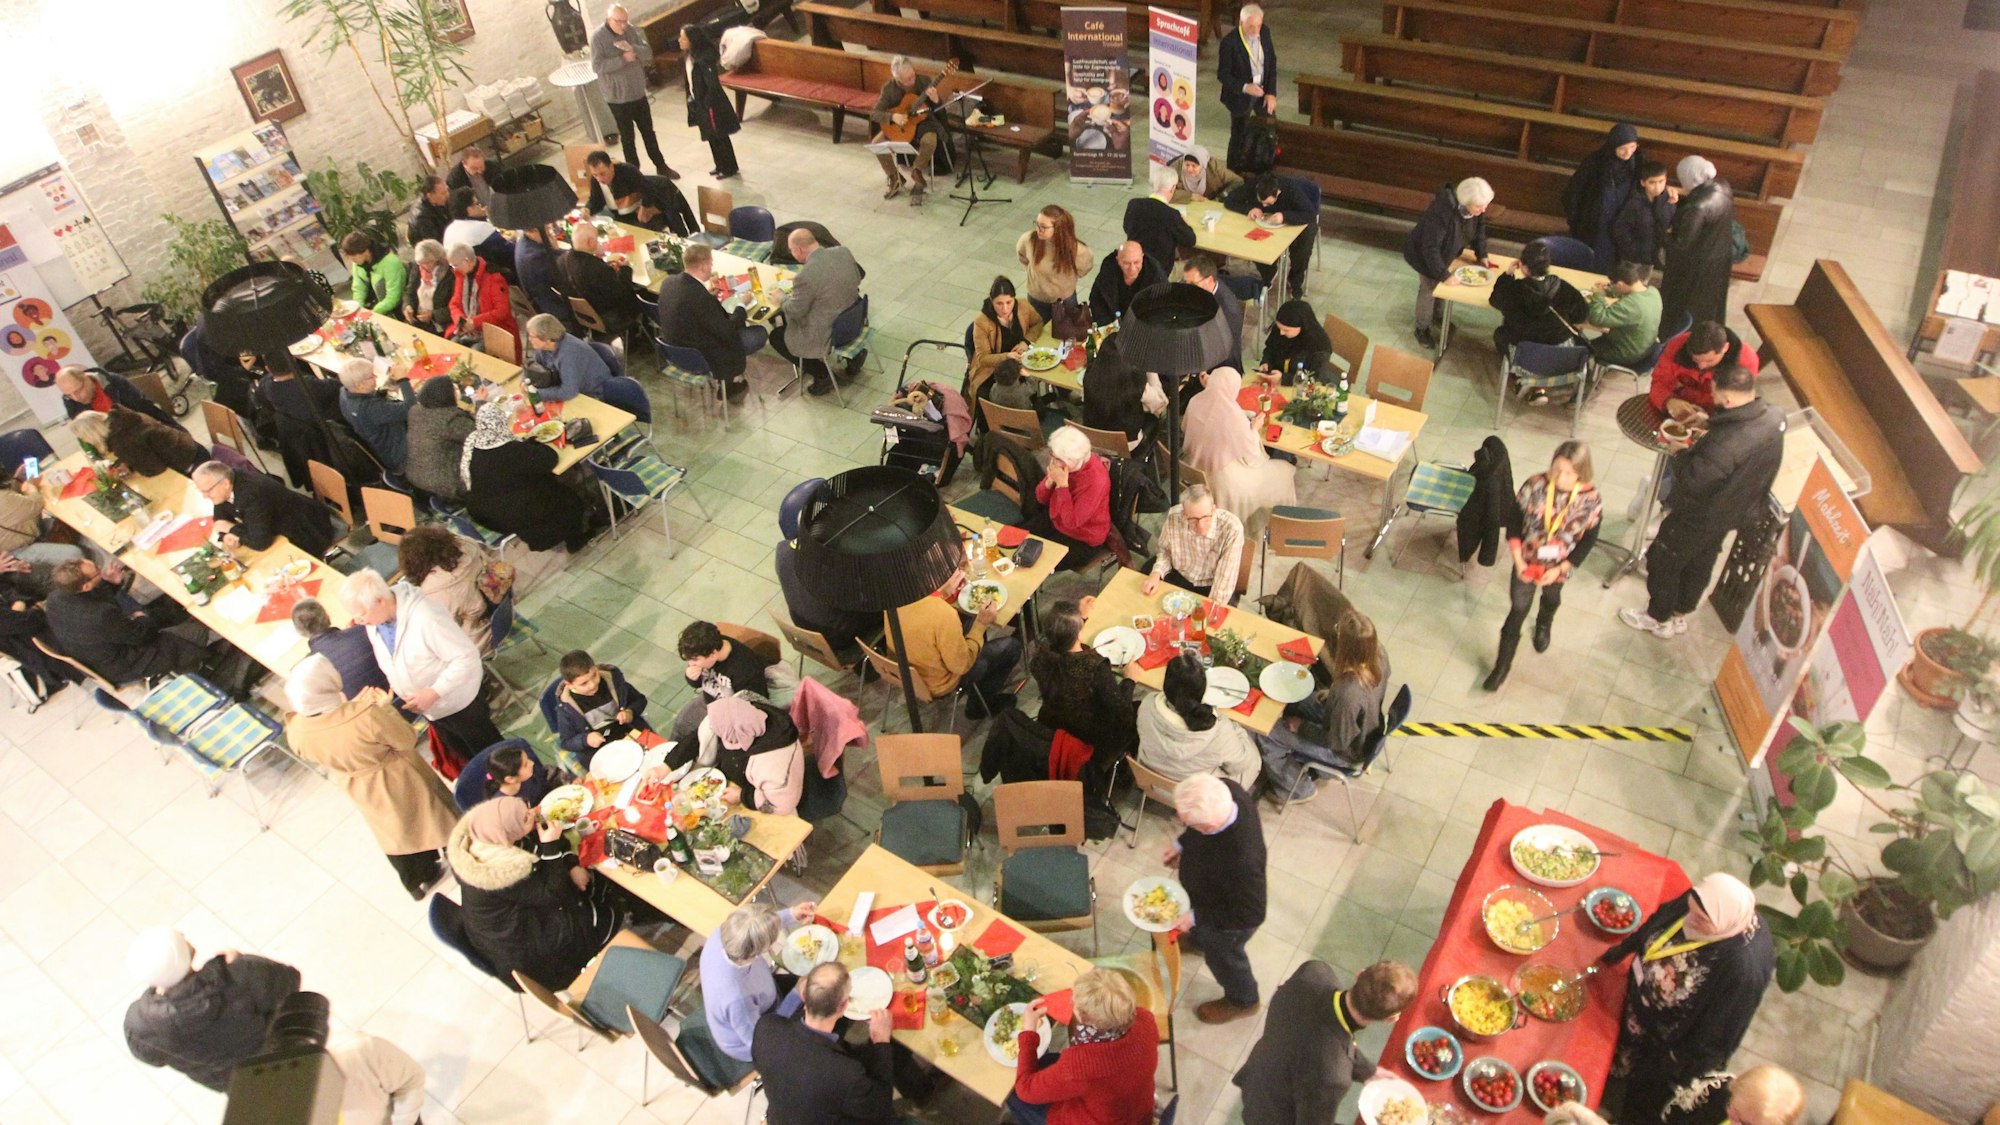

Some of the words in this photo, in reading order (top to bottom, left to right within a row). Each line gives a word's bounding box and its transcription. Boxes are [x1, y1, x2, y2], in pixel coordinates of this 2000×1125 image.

[1084, 20, 1105, 30] Café
[1156, 17, 1191, 37] Sprachcafé
[1067, 32, 1123, 41] International
